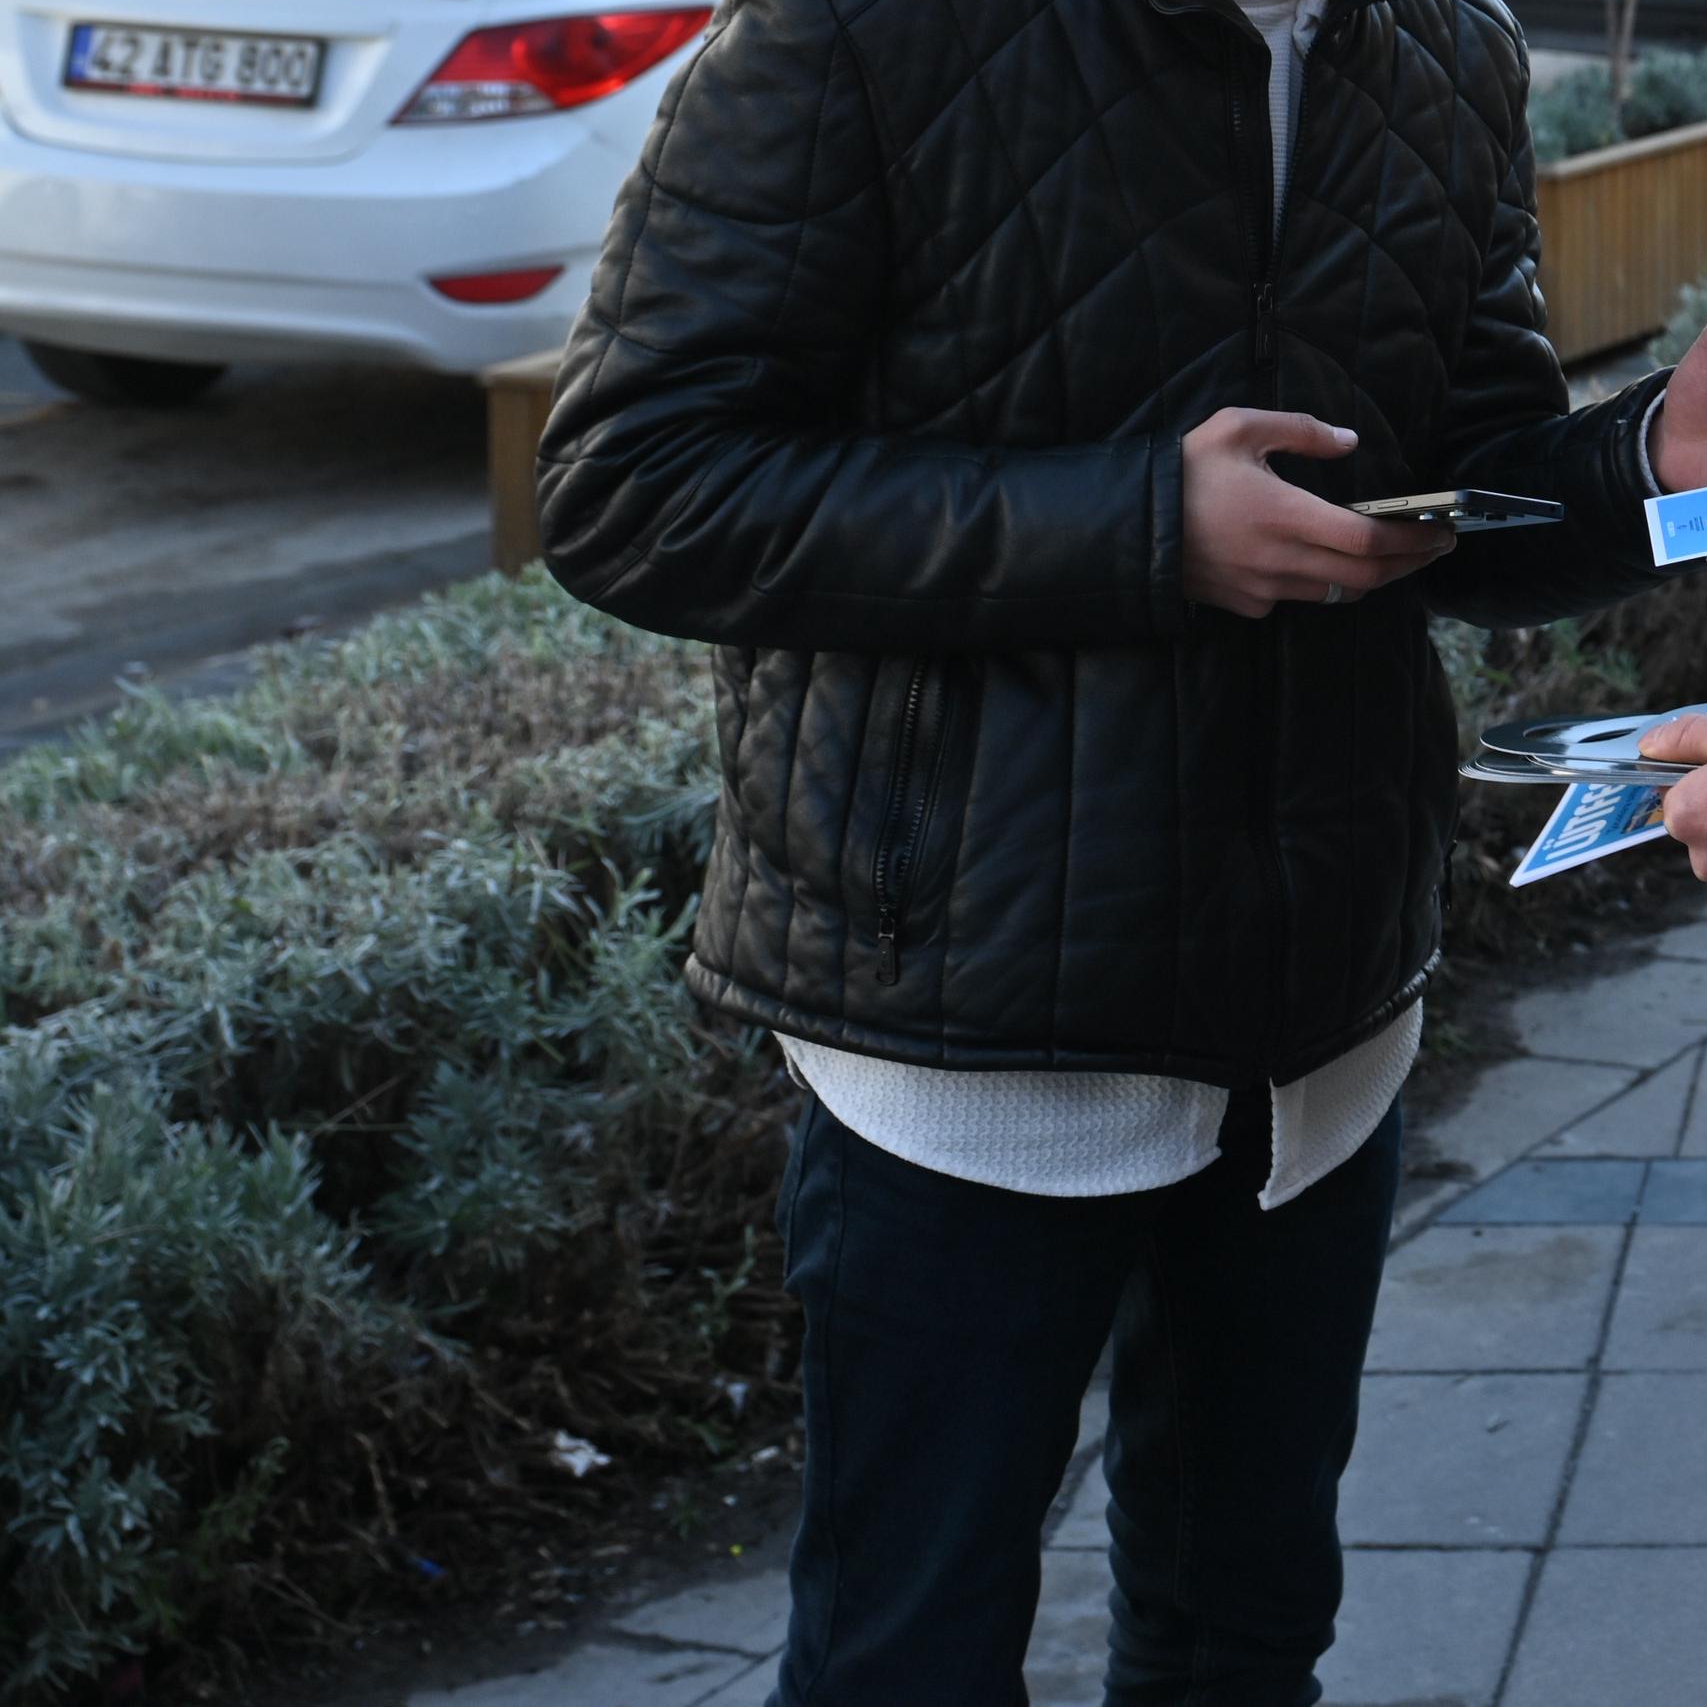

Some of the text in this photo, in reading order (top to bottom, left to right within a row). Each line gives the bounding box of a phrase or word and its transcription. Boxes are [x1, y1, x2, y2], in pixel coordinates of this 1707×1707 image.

[90, 30, 309, 91] 42 ATG 800
